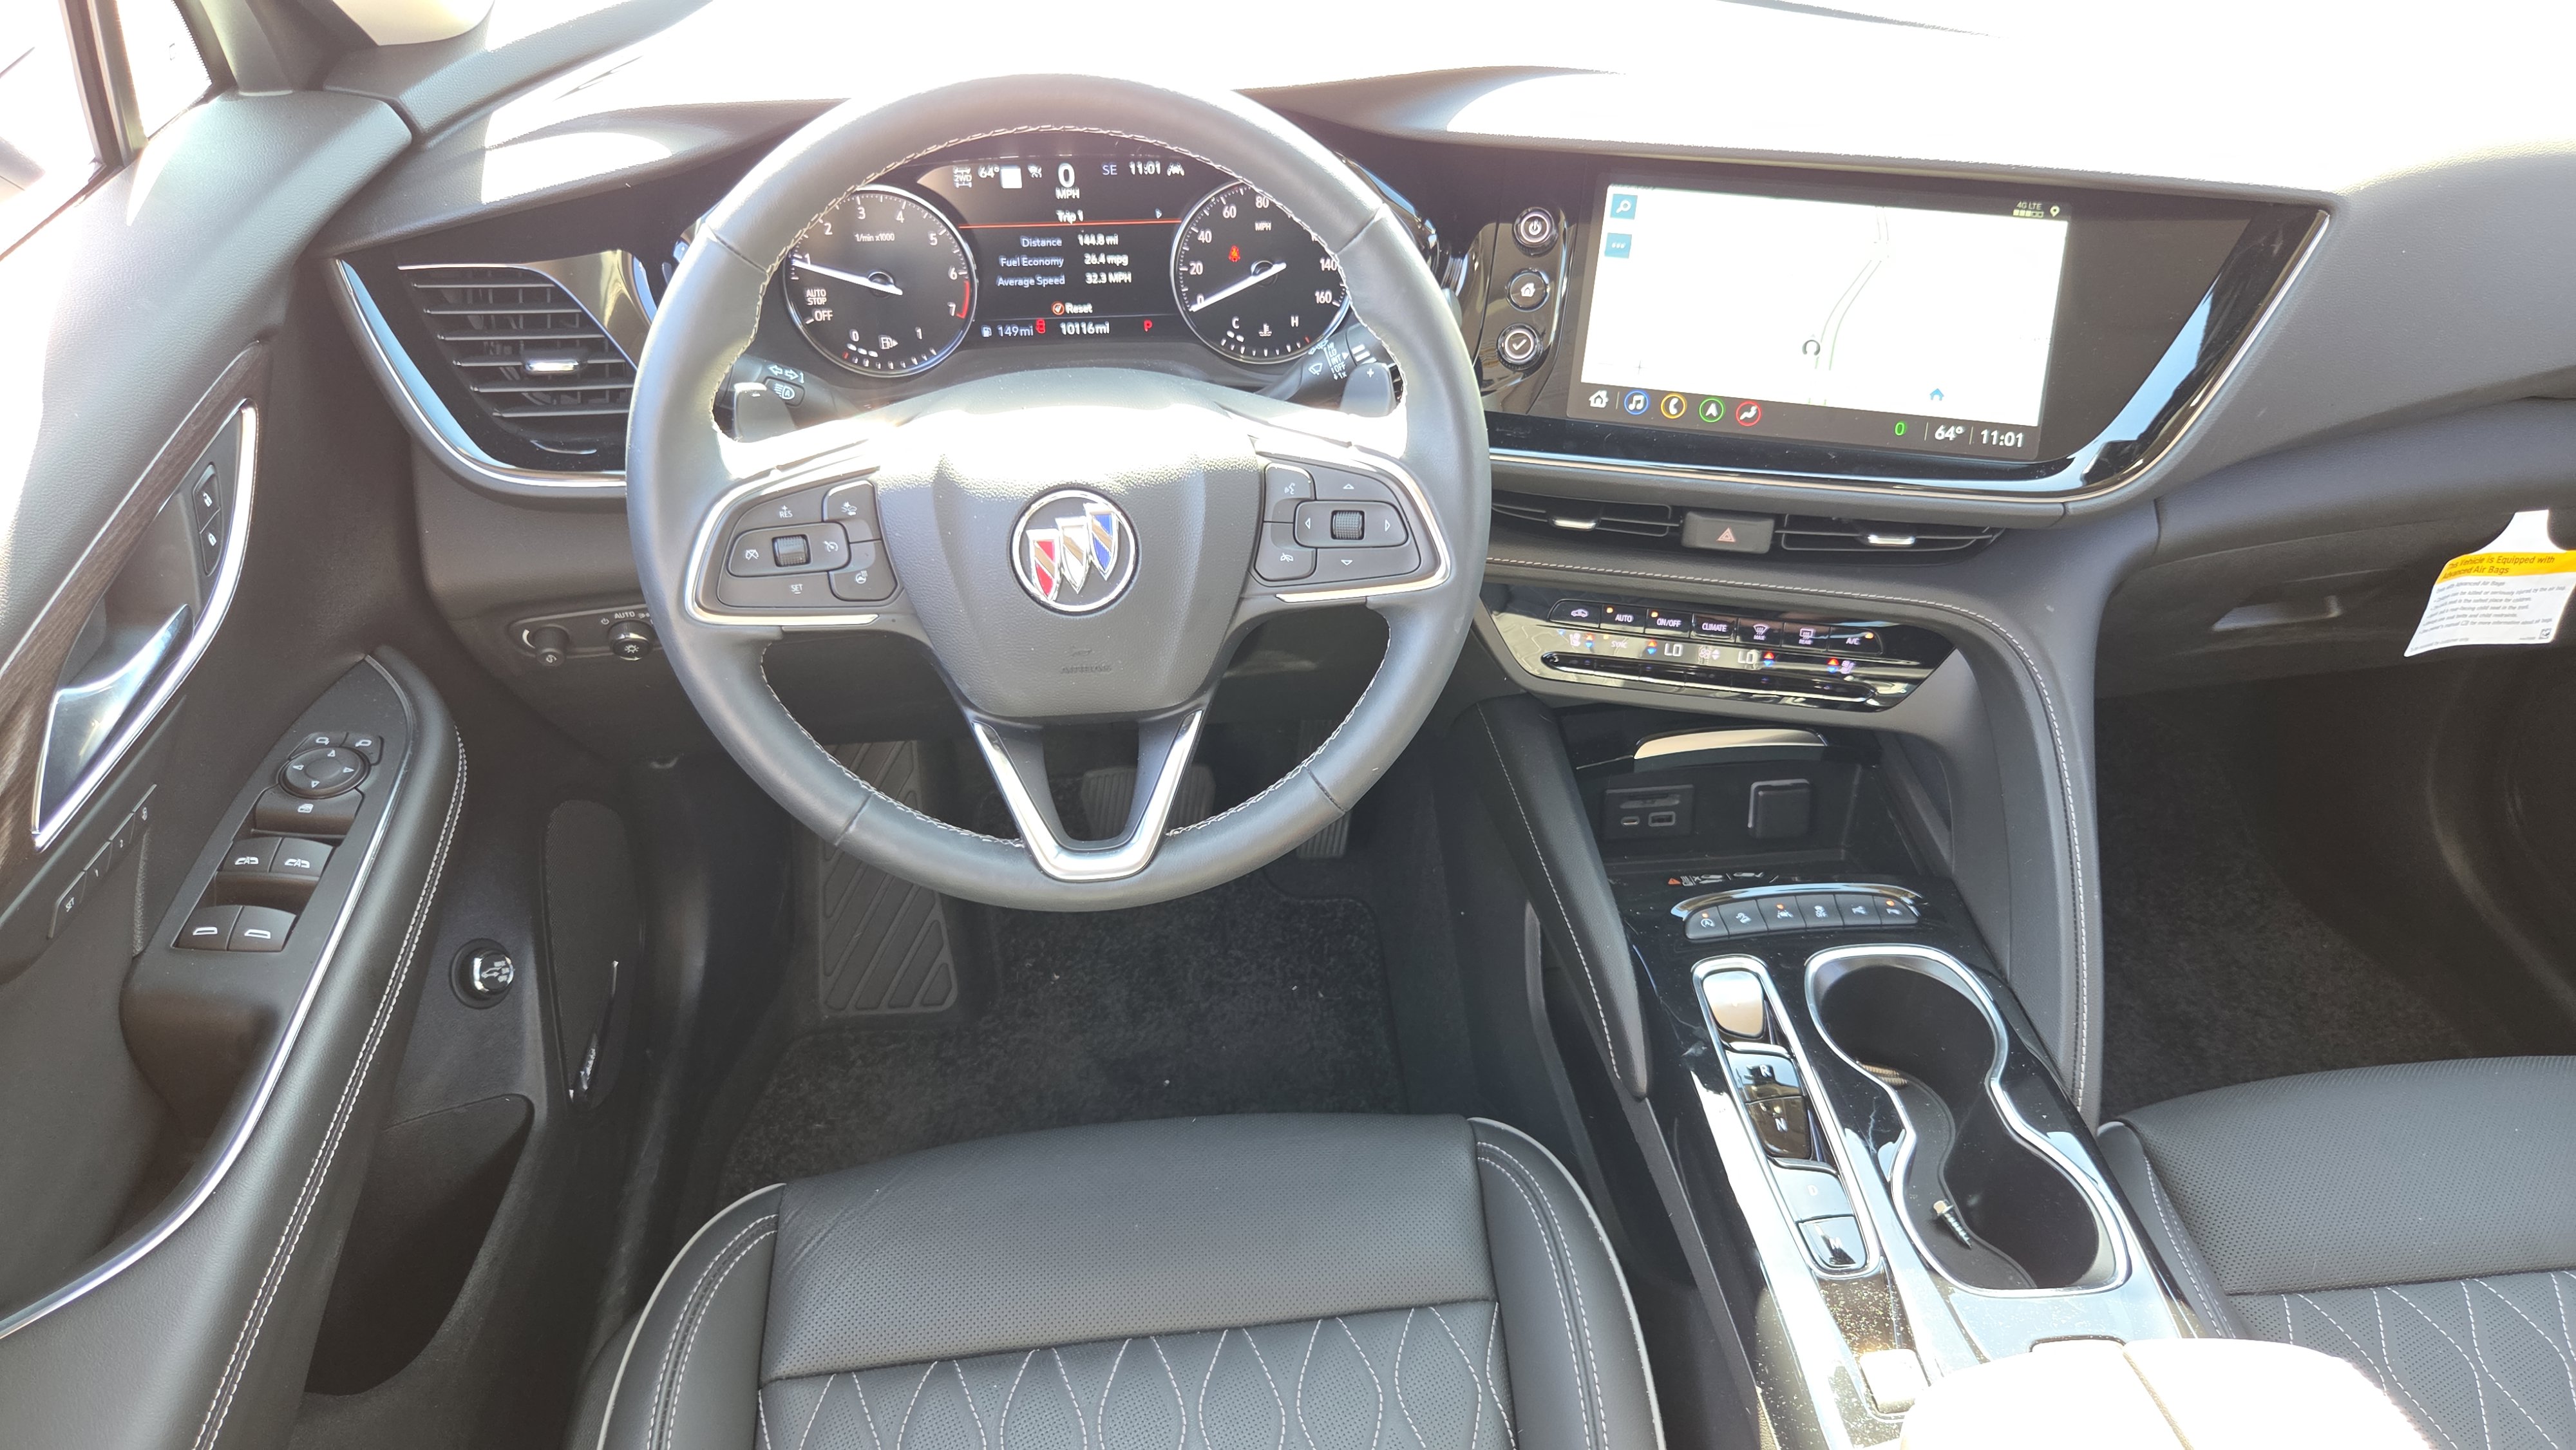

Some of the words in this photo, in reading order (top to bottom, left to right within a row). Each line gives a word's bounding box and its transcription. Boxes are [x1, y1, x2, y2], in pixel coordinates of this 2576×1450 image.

[1102, 164, 1117, 175] SE
[1129, 161, 1160, 175] 11:01
[1057, 163, 1075, 187] 0
[1056, 187, 1080, 199] MPH
[1256, 196, 1269, 208] 80
[2028, 202, 2043, 210] LTE
[858, 206, 866, 220] 3
[896, 210, 904, 223] 4
[1056, 210, 1076, 224] Trip
[1077, 209, 1084, 221] 1
[1223, 204, 1236, 218] 60
[824, 222, 833, 235] 2
[1255, 221, 1271, 231] MPH
[875, 233, 895, 241] x1000
[929, 233, 938, 246] 5
[1020, 236, 1062, 247] Distance
[1077, 234, 1104, 246] 144.8
[1106, 234, 1119, 245] mi
[1198, 230, 1212, 243] 40
[804, 253, 811, 264] 1
[999, 256, 1020, 267] Fuel
[1021, 255, 1064, 268] Economy
[1084, 253, 1105, 265] 26.4
[1106, 254, 1128, 267] mpg
[1320, 257, 1338, 271] 140
[949, 265, 957, 280] 6
[1189, 261, 1203, 275] 20
[996, 276, 1035, 288] Average
[1036, 274, 1065, 288] Speed
[1085, 272, 1107, 284] 32.3
[1108, 272, 1132, 283] MPH
[806, 288, 826, 297] AUTO
[1314, 290, 1332, 304] 160
[807, 297, 827, 305] STOP
[1197, 294, 1204, 305] 0
[948, 302, 956, 315] 7
[1065, 303, 1093, 314] Reset
[814, 309, 833, 321] OFF
[1291, 315, 1299, 327] H
[1231, 315, 1240, 329] C
[851, 329, 860, 341] 0
[915, 326, 922, 339] 1
[1334, 362, 1345, 373] OFF
[1895, 421, 1906, 436] 0
[1981, 429, 2024, 447] 11:01
[779, 510, 793, 519] RES
[2459, 556, 2485, 566] Vehicle
[2496, 556, 2535, 565] Equipped
[2488, 566, 2510, 575] Bags
[791, 584, 803, 592] SET
[614, 611, 636, 619] AUTO
[1615, 614, 1633, 623] AUTO
[1656, 618, 1682, 628] ON/OFF
[1702, 622, 1728, 632] CLIMATE
[1664, 643, 1683, 657] LO
[119, 839, 124, 848] 2
[1759, 1064, 1772, 1077] R
[1775, 1118, 1788, 1132] N
[1807, 1184, 1818, 1196] D
